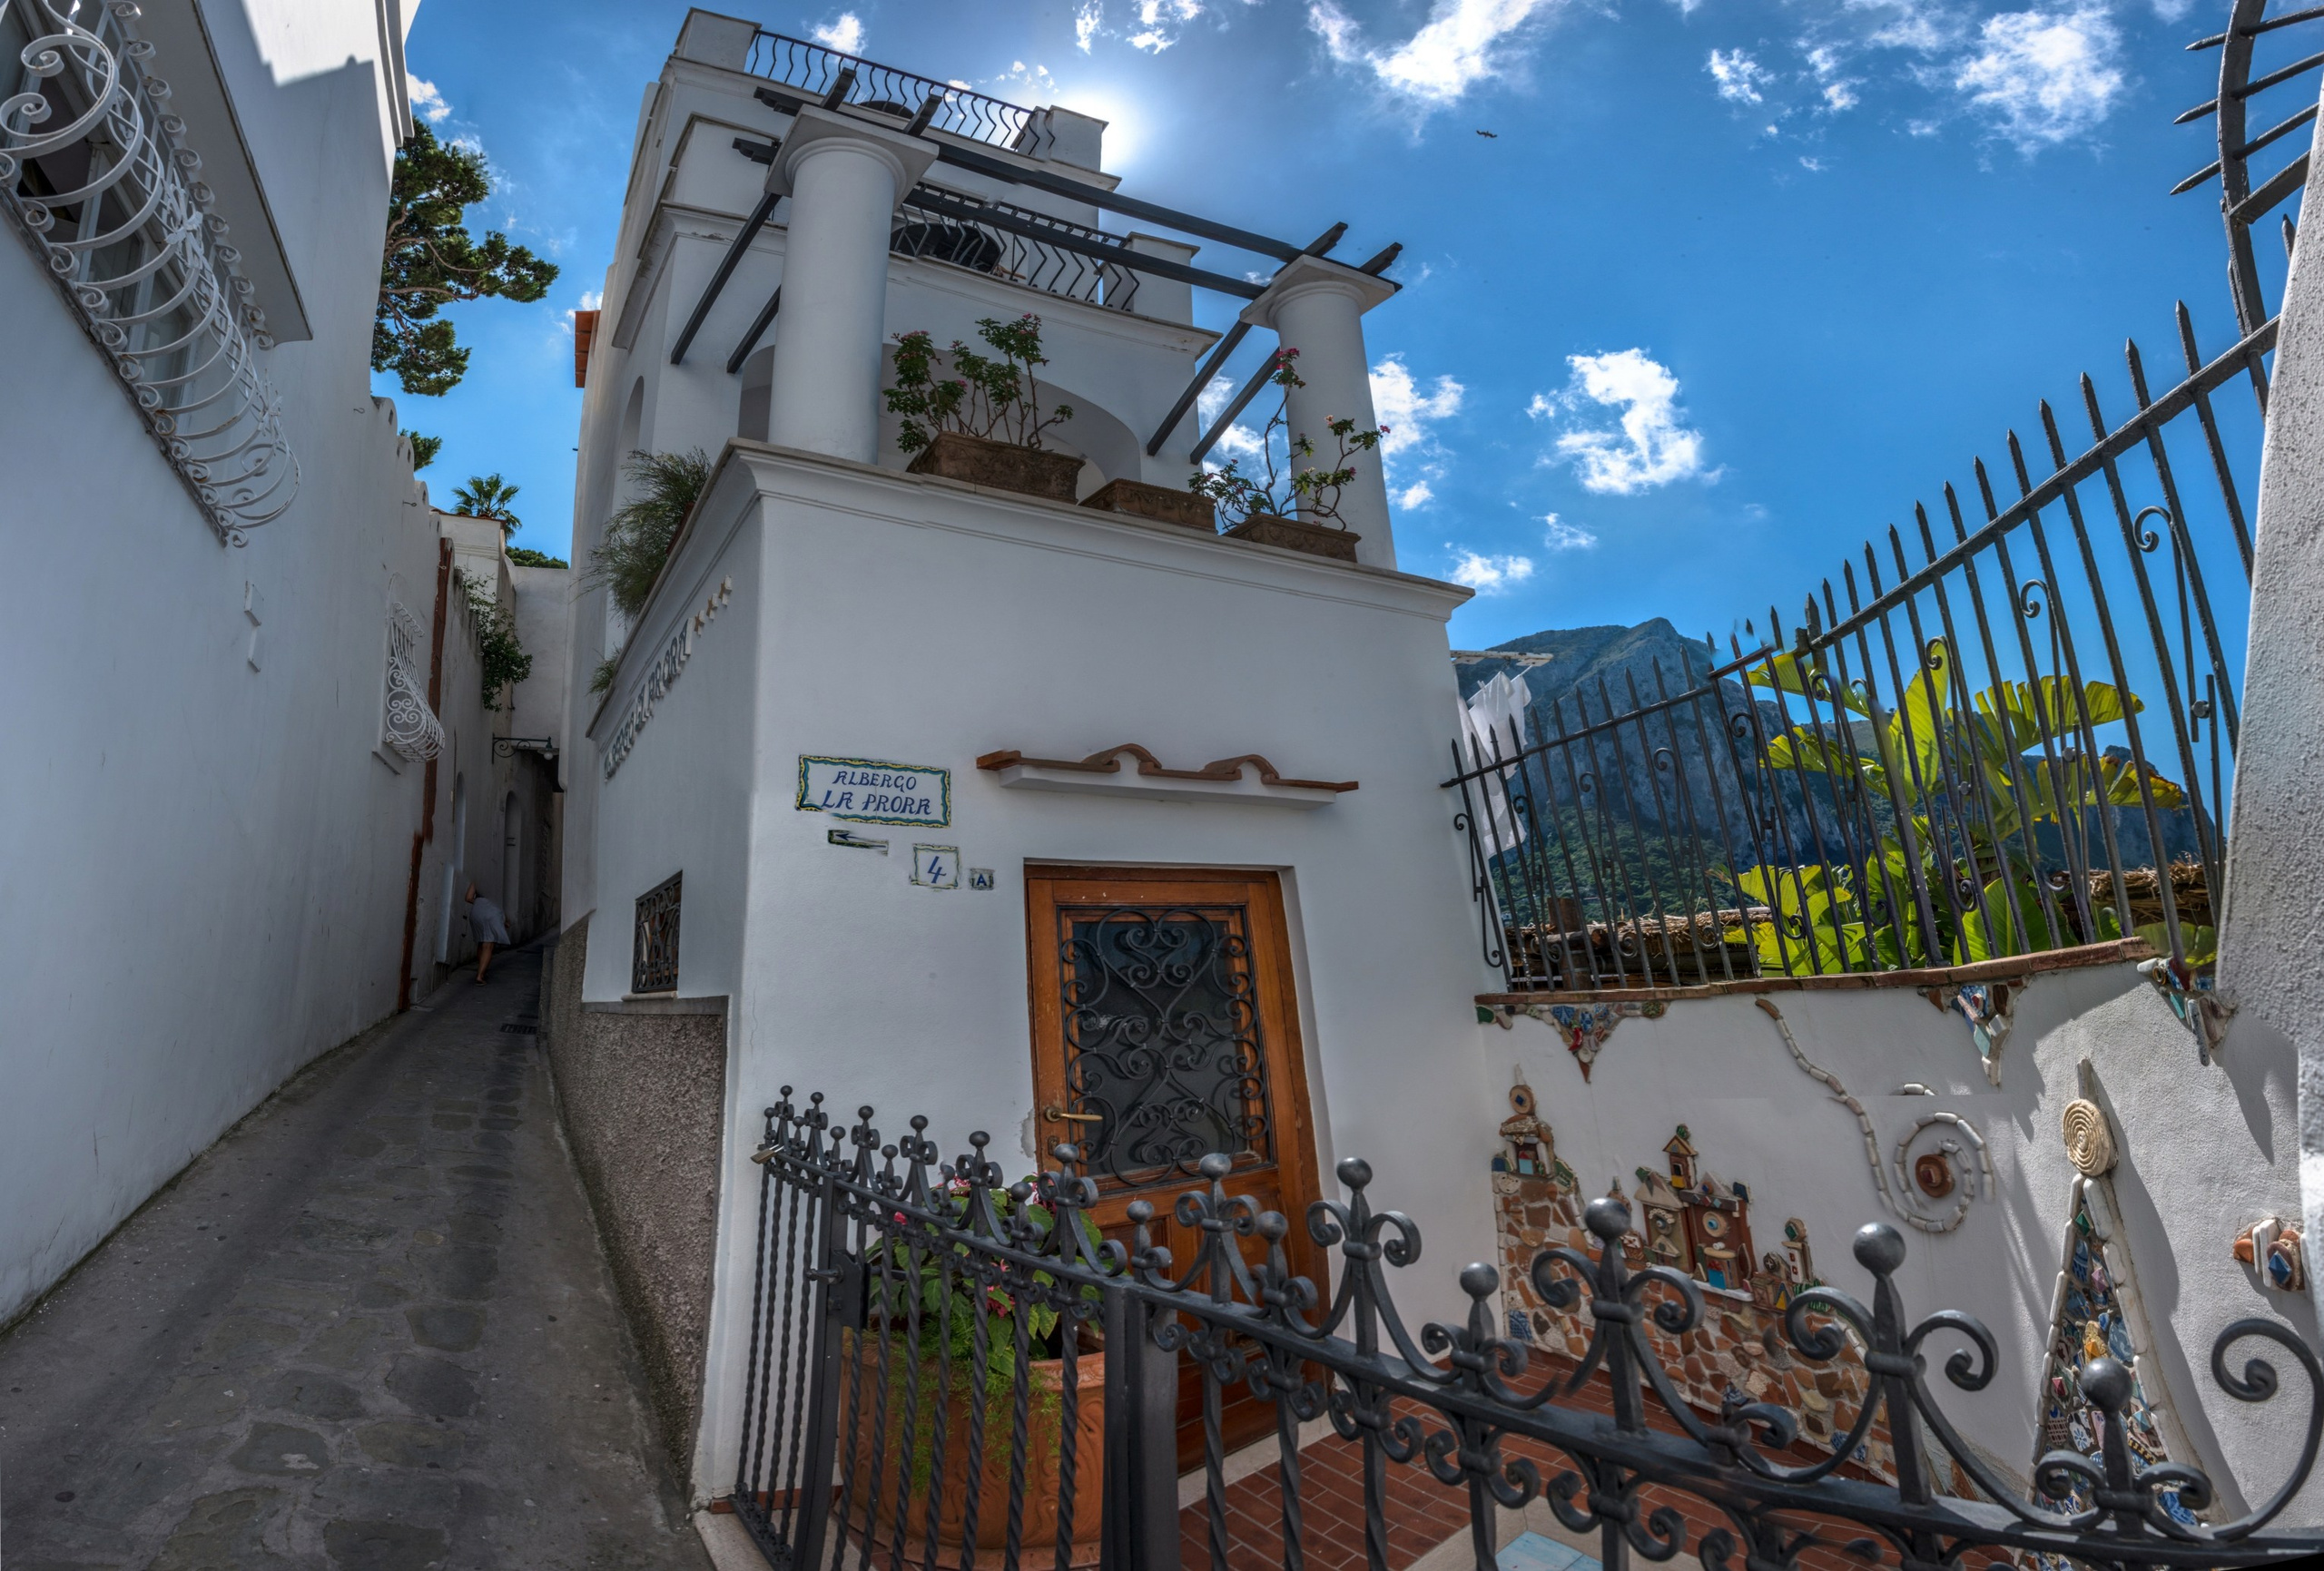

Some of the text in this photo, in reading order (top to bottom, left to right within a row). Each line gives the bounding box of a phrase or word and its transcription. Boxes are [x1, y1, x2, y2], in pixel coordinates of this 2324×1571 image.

[832, 771, 917, 793] ALBERGO
[821, 790, 932, 816] LA PRORA
[927, 856, 947, 884] 4
[976, 873, 987, 887] A
